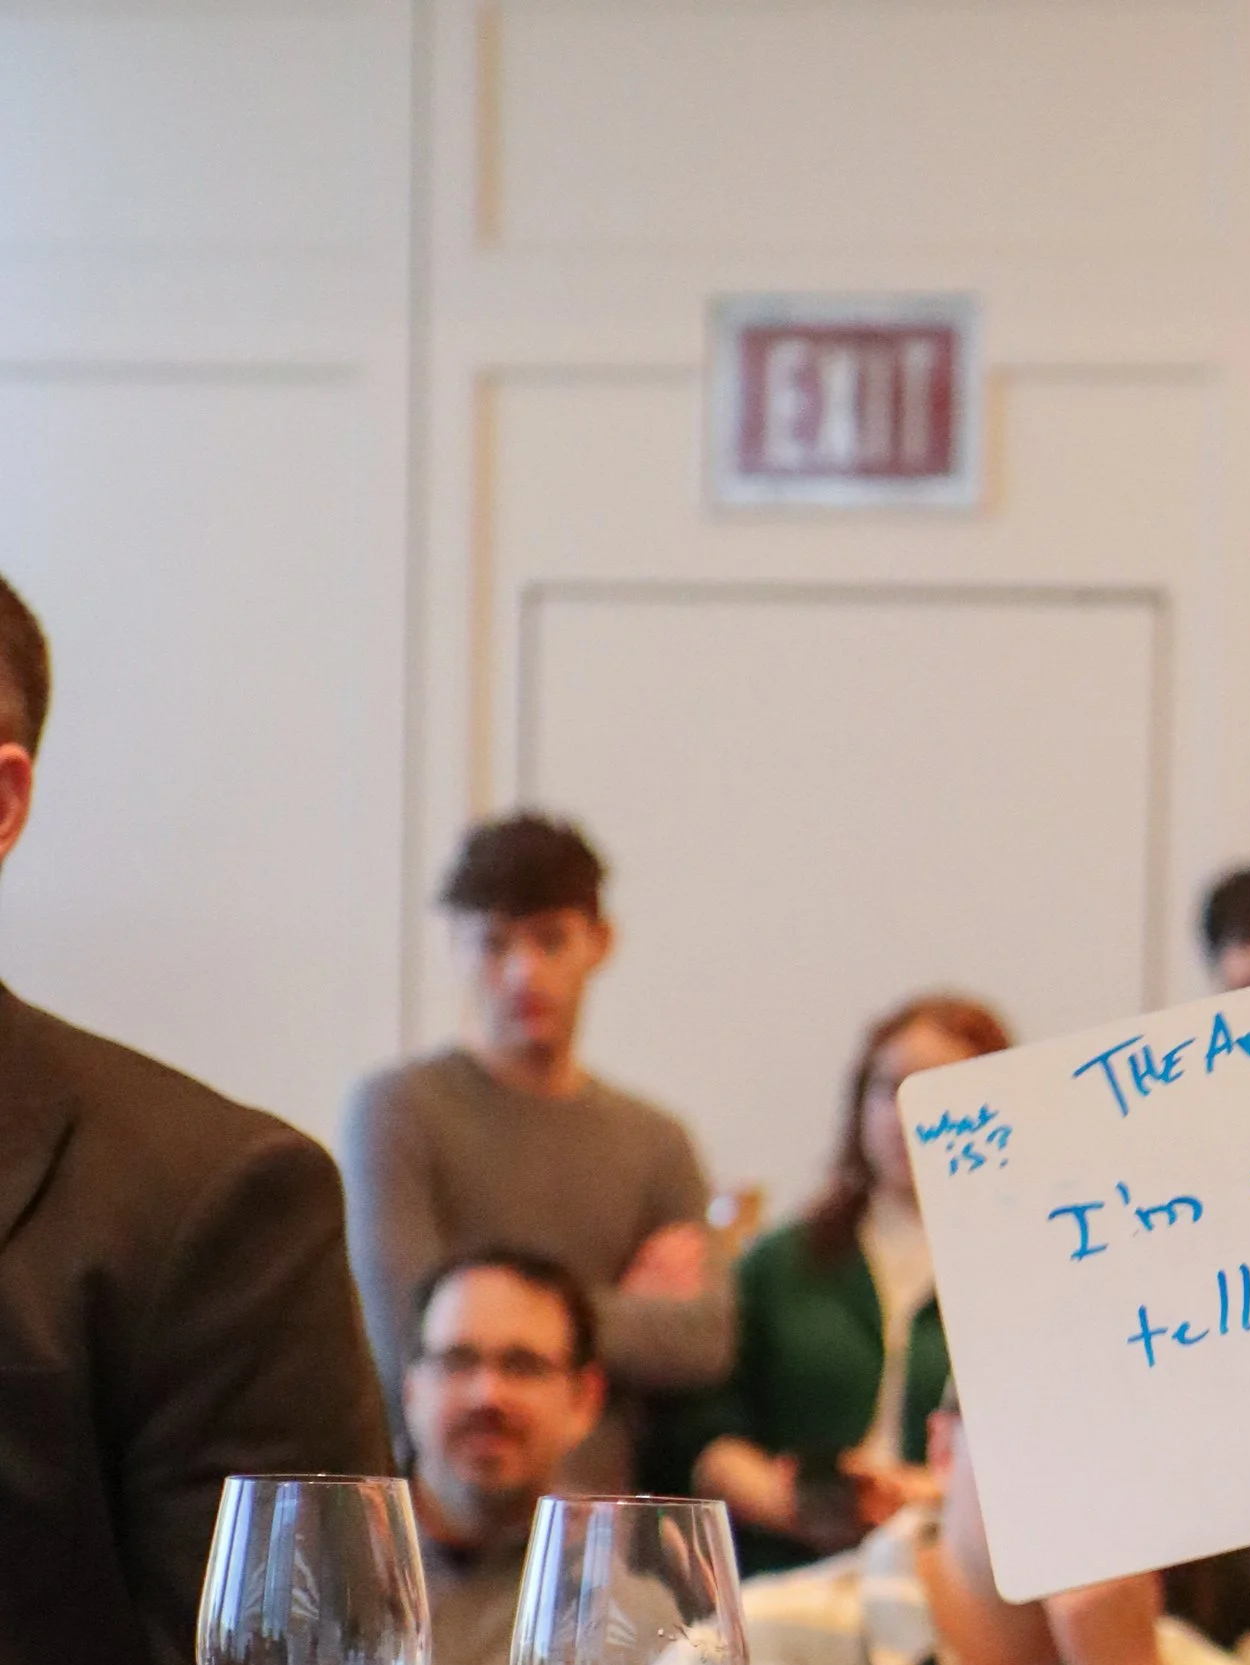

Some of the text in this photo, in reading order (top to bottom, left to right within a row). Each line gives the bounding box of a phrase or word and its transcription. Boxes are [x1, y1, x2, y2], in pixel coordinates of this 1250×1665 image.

[1073, 1033, 1196, 1117] THE
[945, 1125, 1013, 1176] is?
[1047, 1182, 1205, 1261] I'm
